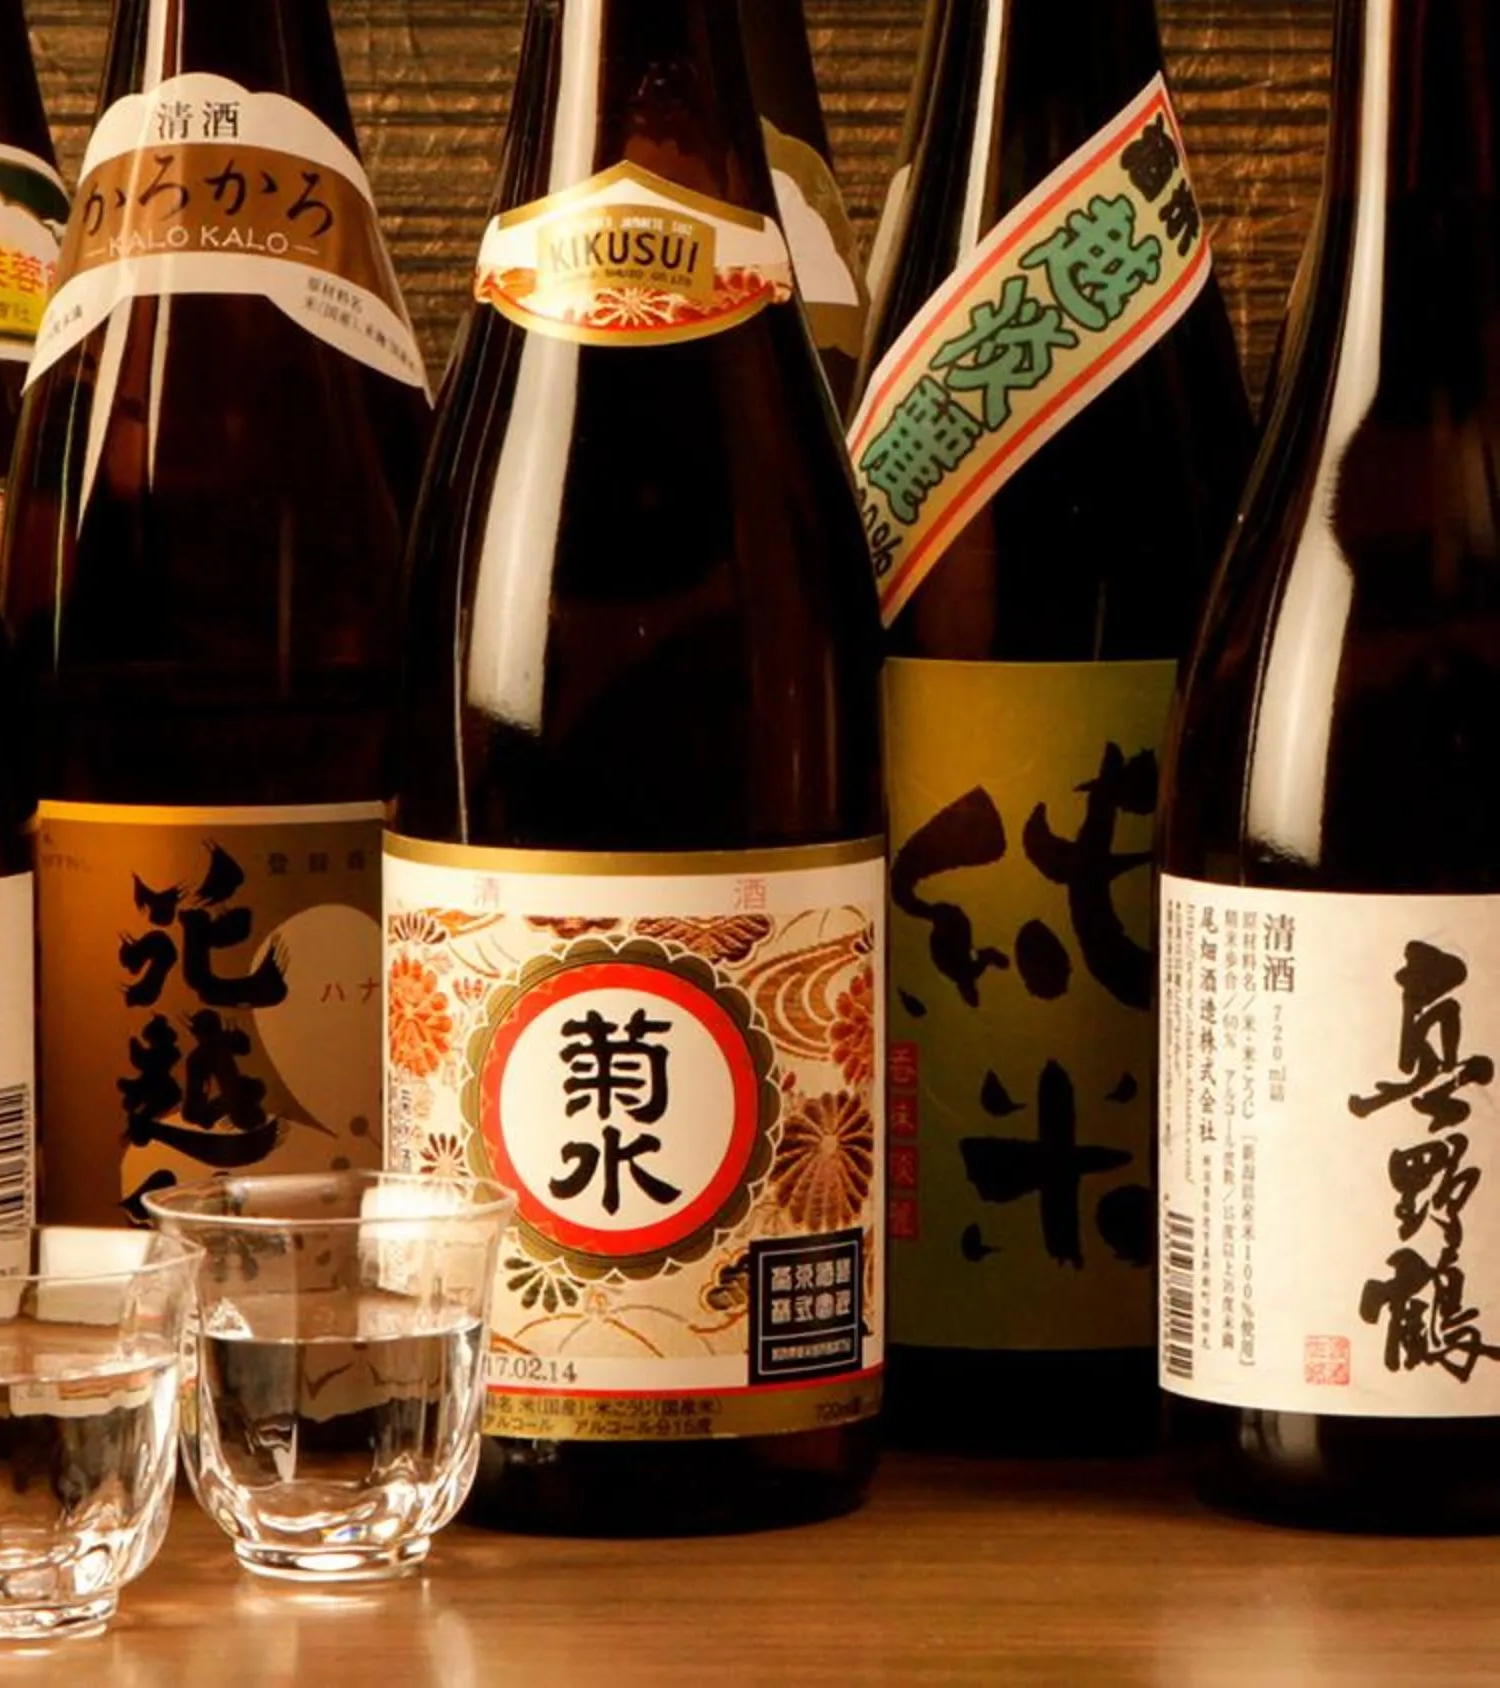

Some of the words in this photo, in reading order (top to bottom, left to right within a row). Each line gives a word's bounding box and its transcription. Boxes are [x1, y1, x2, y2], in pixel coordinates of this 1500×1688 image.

[157, 101, 240, 140] 清酒
[83, 155, 333, 237] かろかろ
[109, 225, 190, 257] KALO
[200, 226, 290, 252] KALO
[550, 231, 699, 275] KIKUSUI
[1263, 912, 1296, 994] 清酒
[1199, 905, 1218, 1144] 尾畑酒造株式会社
[549, 1008, 683, 1216] 菊水
[1347, 940, 1500, 1384] 真野鶴
